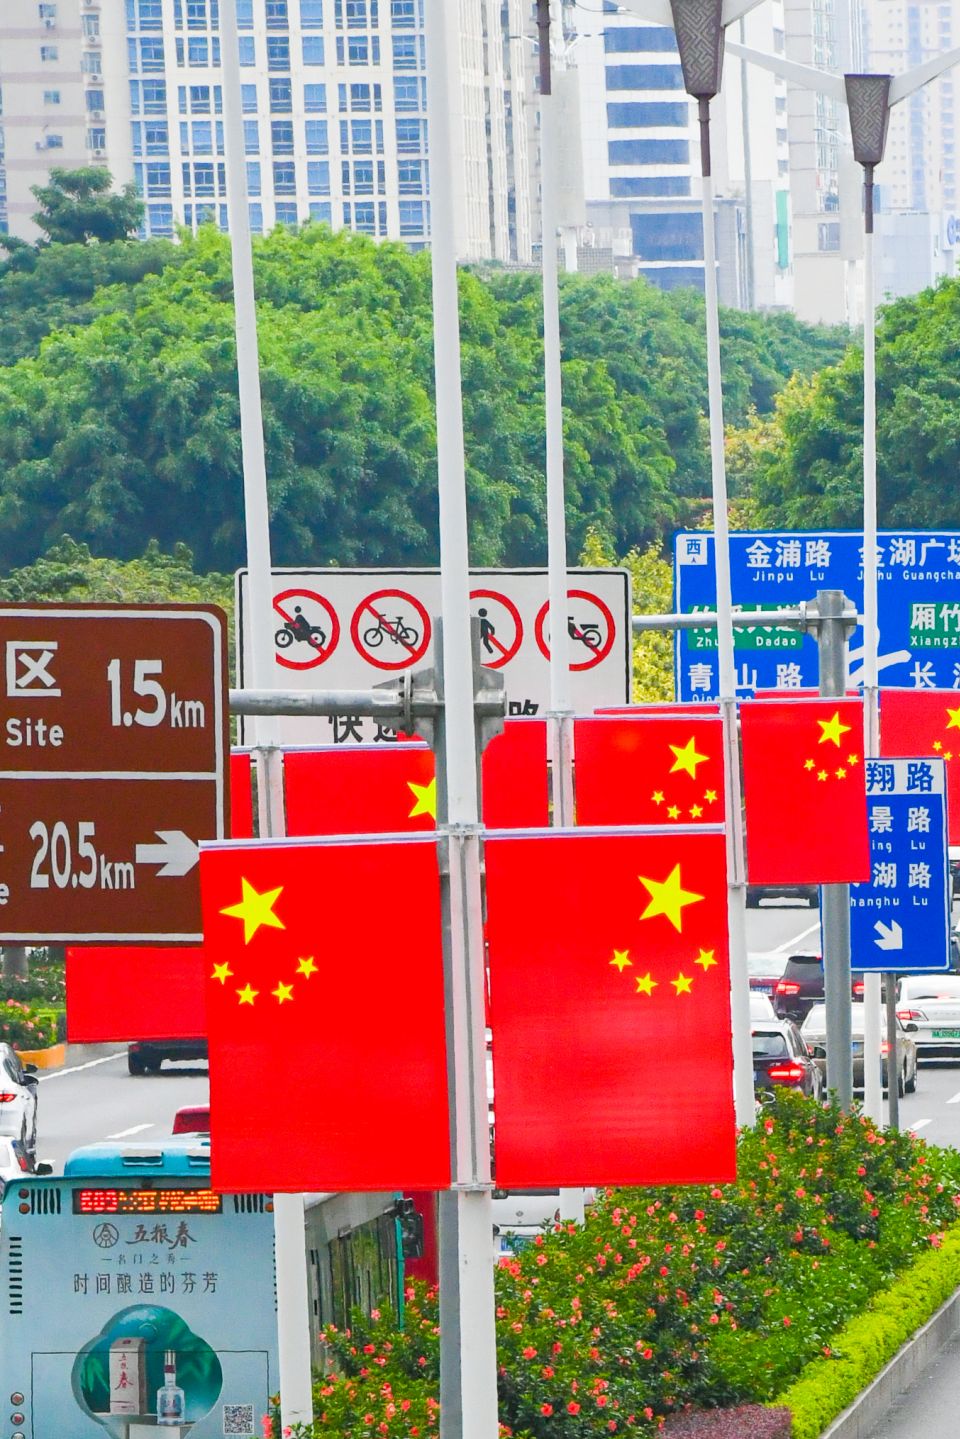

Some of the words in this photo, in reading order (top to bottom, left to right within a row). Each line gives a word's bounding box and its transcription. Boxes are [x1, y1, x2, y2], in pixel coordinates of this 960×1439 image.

[685, 538, 702, 556] 西
[745, 538, 833, 568] 金浦路
[752, 569, 794, 583] Jinpu
[810, 570, 825, 582] Lu
[857, 570, 893, 582] Jhu
[755, 636, 797, 647] Dadao
[687, 662, 804, 692] 青山路
[5, 716, 65, 747] Site
[28, 820, 136, 890] 20.5km
[910, 839, 927, 851] Lu
[853, 861, 932, 890] 湖路
[912, 895, 929, 907] Lu
[125, 1220, 198, 1250] 五粮春
[73, 1271, 219, 1296] 时间酿造的芬芳
